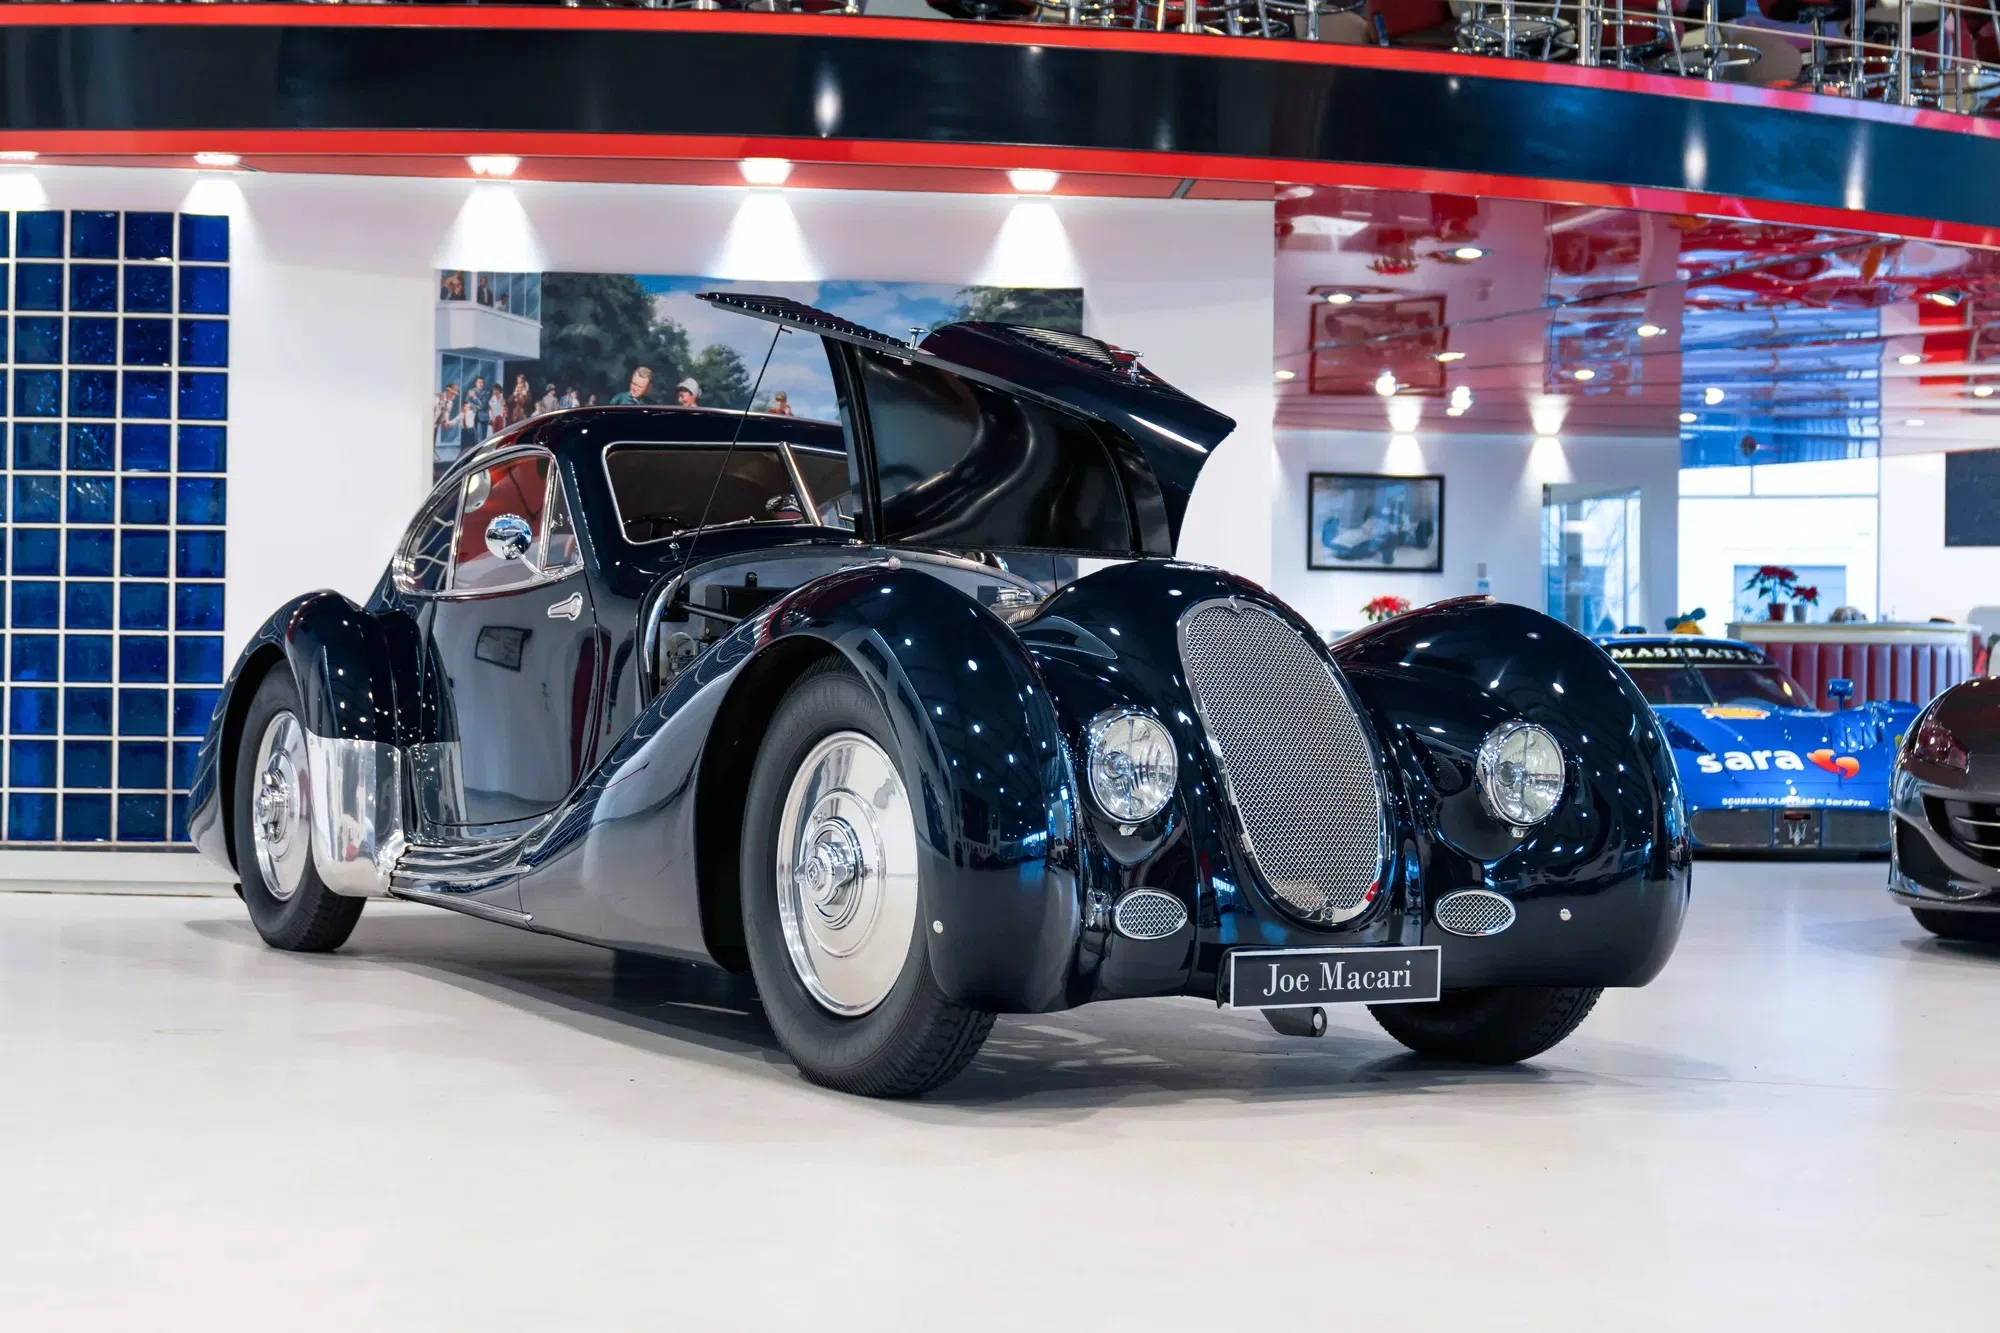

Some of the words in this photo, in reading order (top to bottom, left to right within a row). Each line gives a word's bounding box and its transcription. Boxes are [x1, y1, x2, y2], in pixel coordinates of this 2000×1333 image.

[1610, 647, 1748, 661] MASERATI
[1696, 749, 1805, 774] sara
[1722, 797, 1768, 806] SCUDERIA
[1768, 797, 1816, 806] PLATEAM
[1263, 963, 1310, 997] Joe
[1318, 960, 1413, 991] Macari
